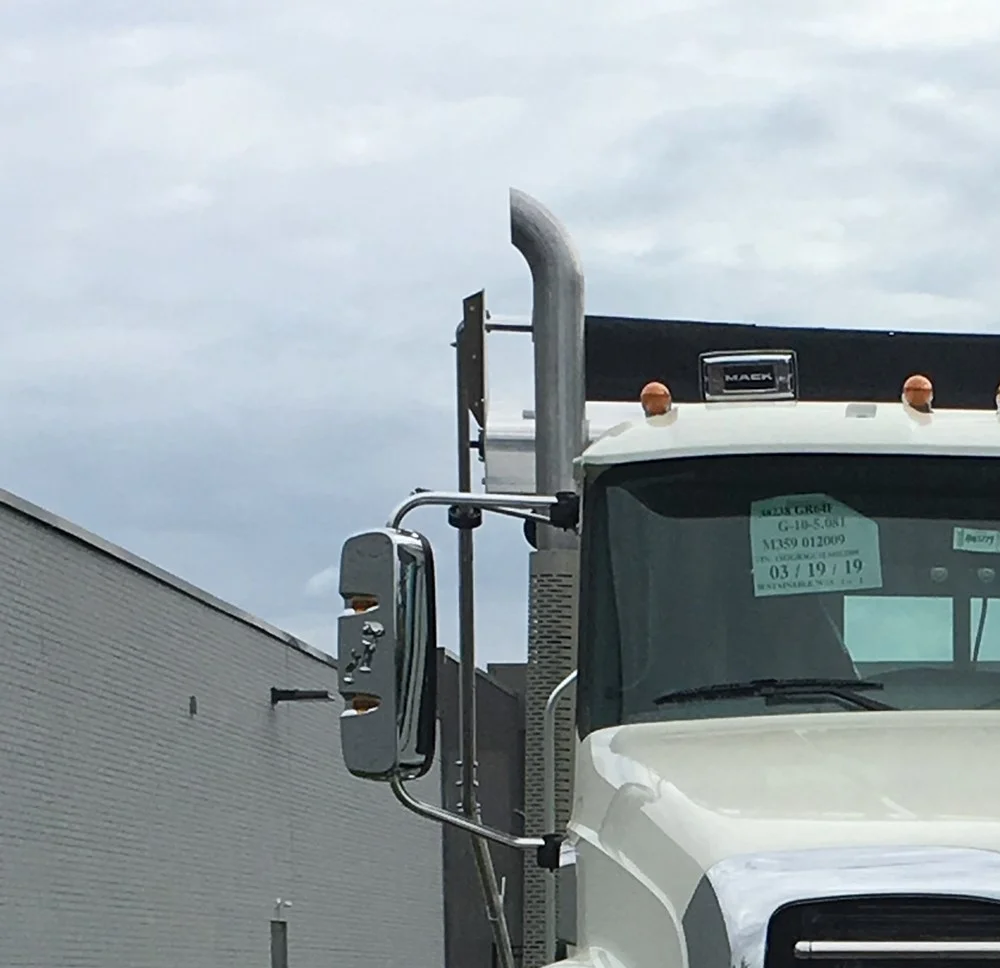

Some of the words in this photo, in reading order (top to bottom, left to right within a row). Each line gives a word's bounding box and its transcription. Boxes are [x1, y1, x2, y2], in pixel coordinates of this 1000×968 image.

[725, 373, 772, 381] MACK
[761, 536, 798, 551] M359
[801, 534, 846, 548] 012009
[768, 564, 789, 580] 03
[808, 561, 826, 578] 19
[845, 558, 863, 574] 19
